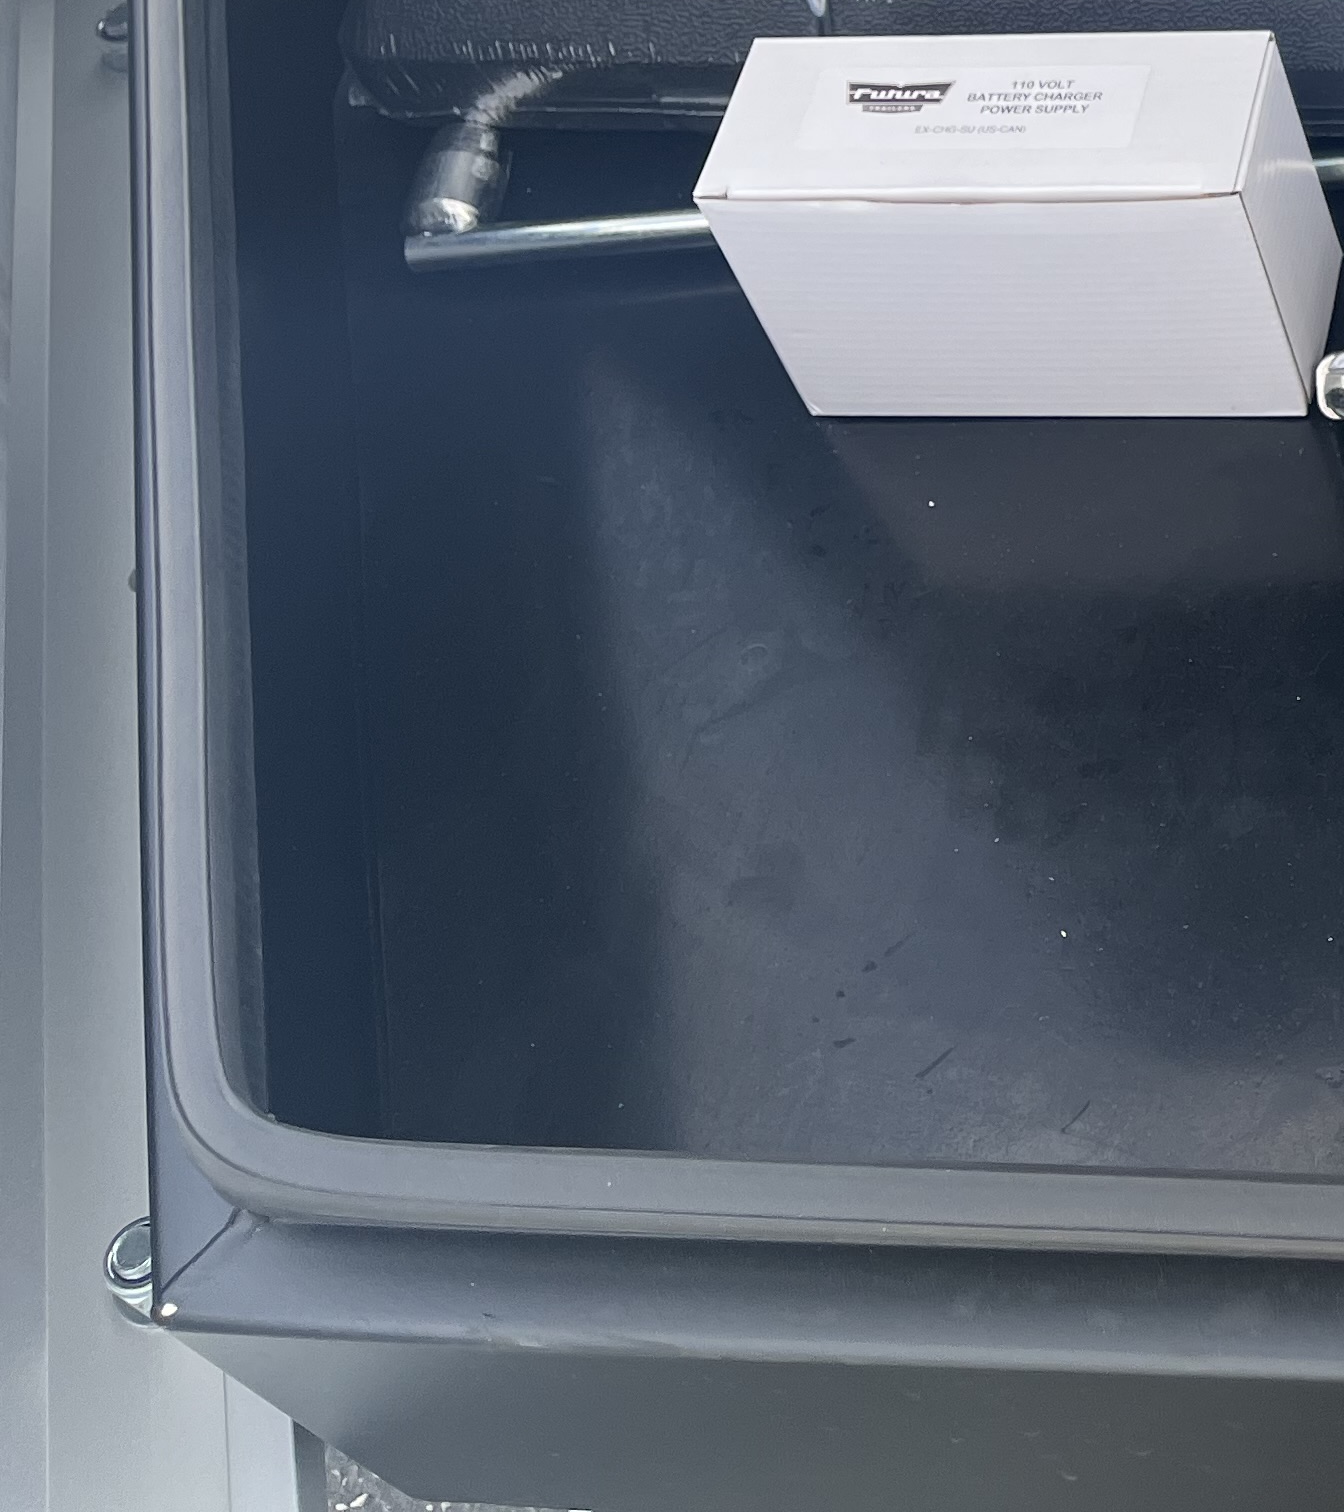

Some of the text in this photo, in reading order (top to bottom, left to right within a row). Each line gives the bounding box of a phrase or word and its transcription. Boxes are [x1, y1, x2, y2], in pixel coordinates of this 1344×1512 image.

[1012, 79, 1076, 90] 110 VOLT
[967, 91, 1104, 103] BATTERY CHARGER
[980, 103, 1091, 115] POWER SUPPLY
